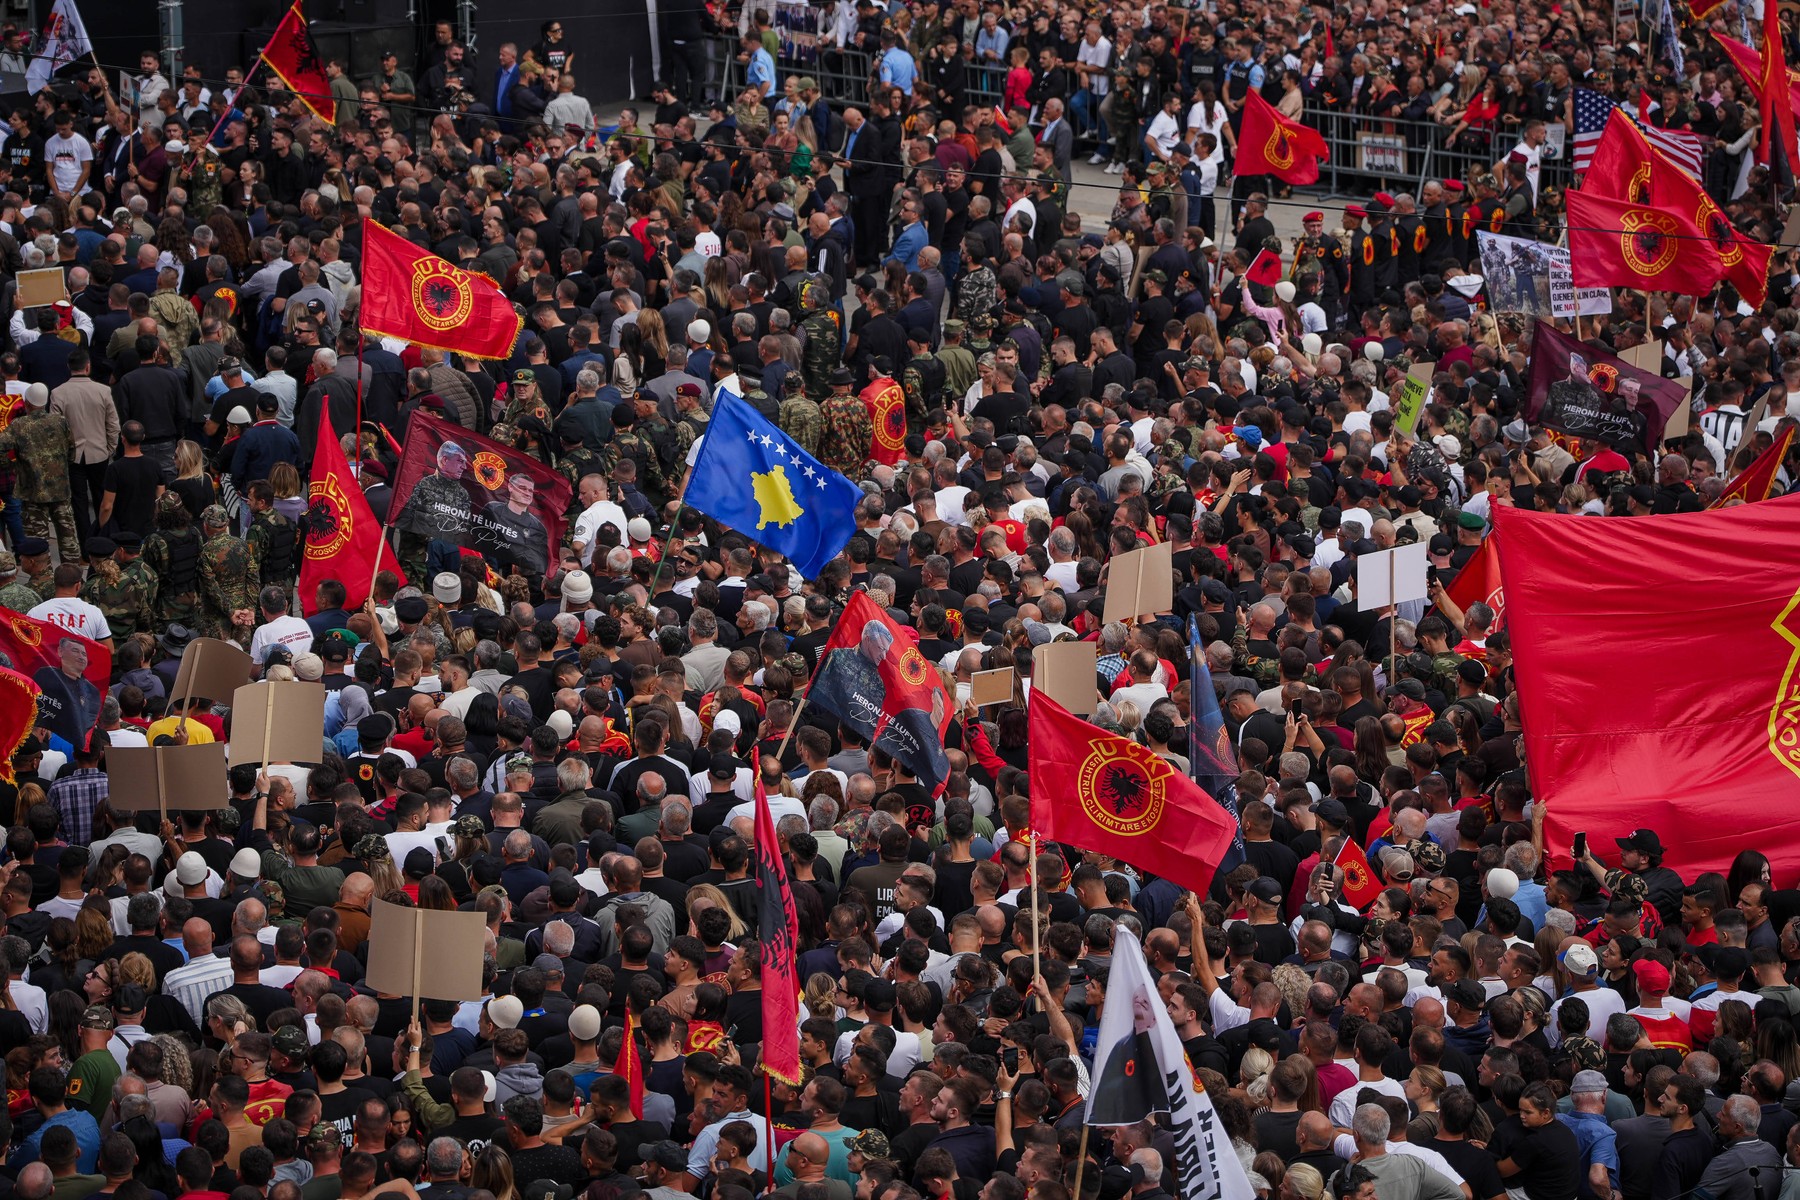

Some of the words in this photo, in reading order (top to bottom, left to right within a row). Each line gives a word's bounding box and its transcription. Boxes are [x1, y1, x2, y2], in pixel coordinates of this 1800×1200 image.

[418, 260, 464, 283] UÇK
[1553, 291, 1589, 302] GJENERLIN
[1563, 403, 1599, 419] HERONJ
[1600, 411, 1611, 421] TË
[479, 453, 505, 469] UÇK
[433, 512, 468, 532] Dhe
[434, 502, 471, 519] HERONJ
[472, 513, 483, 525] TË
[484, 518, 518, 539] LUFTËS
[47, 613, 86, 628] STAF
[945, 610, 960, 620] ÇK
[37, 694, 62, 710] UFTËS
[852, 692, 885, 719] HERONJ
[883, 713, 896, 726] TË
[1097, 741, 1166, 775] UÇK
[1082, 756, 1102, 797] USHTRIA
[910, 807, 933, 823] ÇK
[691, 1031, 724, 1050] ÇK
